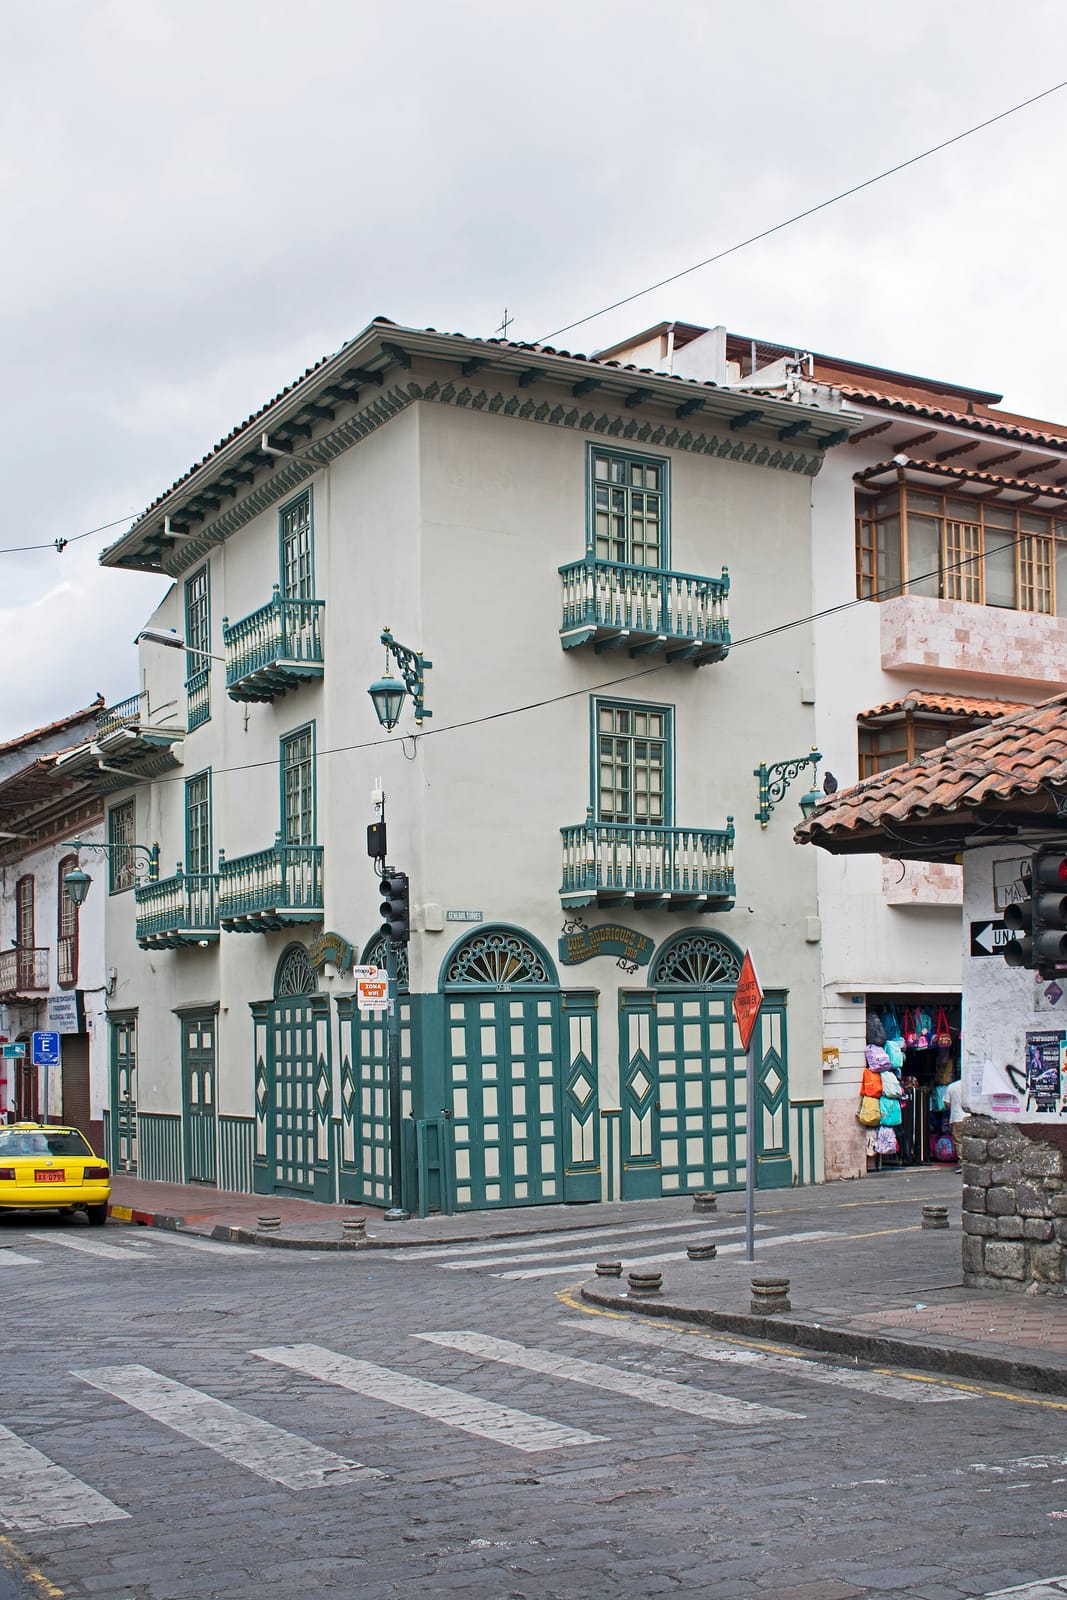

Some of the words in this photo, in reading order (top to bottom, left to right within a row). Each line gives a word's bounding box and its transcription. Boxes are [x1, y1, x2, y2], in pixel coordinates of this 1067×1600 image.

[448, 911, 465, 920] GENERAL
[567, 935, 585, 951] LUIS
[995, 928, 1017, 945] UNA
[41, 1040, 50, 1052] E
